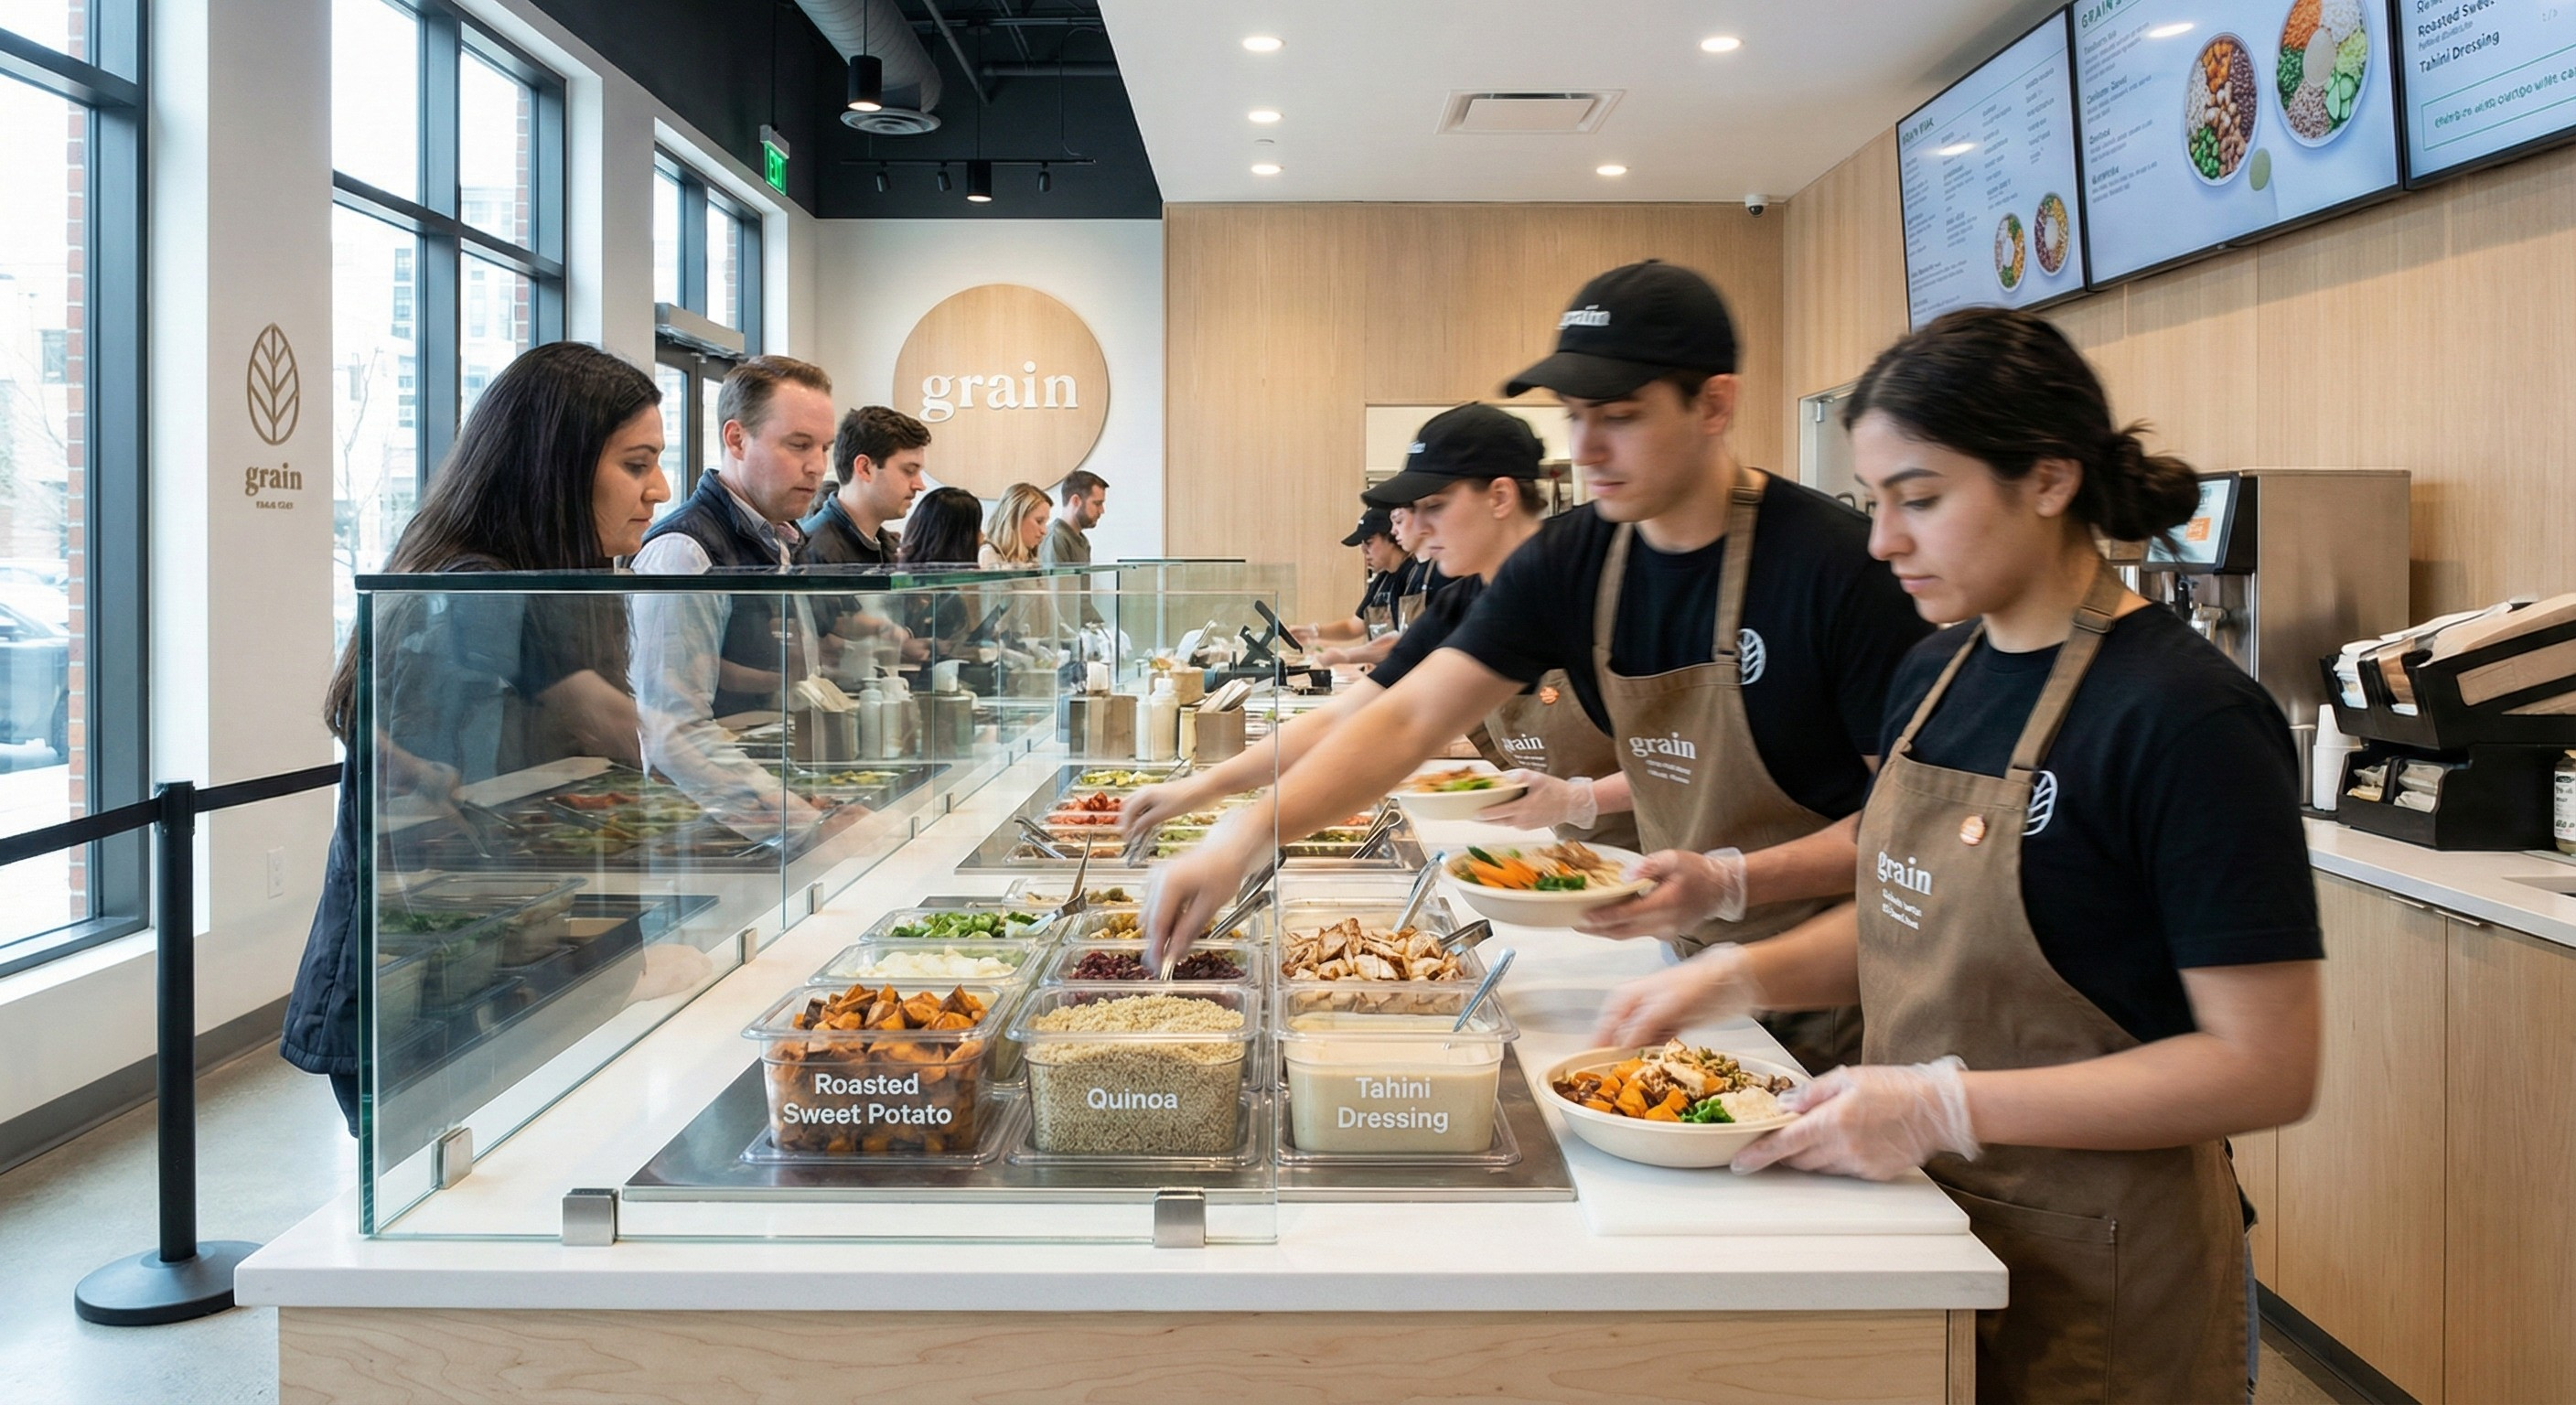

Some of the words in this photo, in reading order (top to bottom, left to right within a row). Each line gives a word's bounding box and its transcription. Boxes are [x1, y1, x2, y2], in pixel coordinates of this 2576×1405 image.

[2453, 31, 2500, 59] Dressing
[918, 360, 1079, 423] grain
[245, 462, 303, 497] grain
[1629, 732, 1696, 758] grain
[1877, 851, 1932, 896] grain
[814, 1073, 919, 1095] Roasted
[1355, 1077, 1431, 1099] Tahini
[1087, 1088, 1178, 1110] Quinoa
[783, 1103, 862, 1125] Sweet
[868, 1103, 952, 1125] Potato
[1337, 1106, 1449, 1133] Dressing
